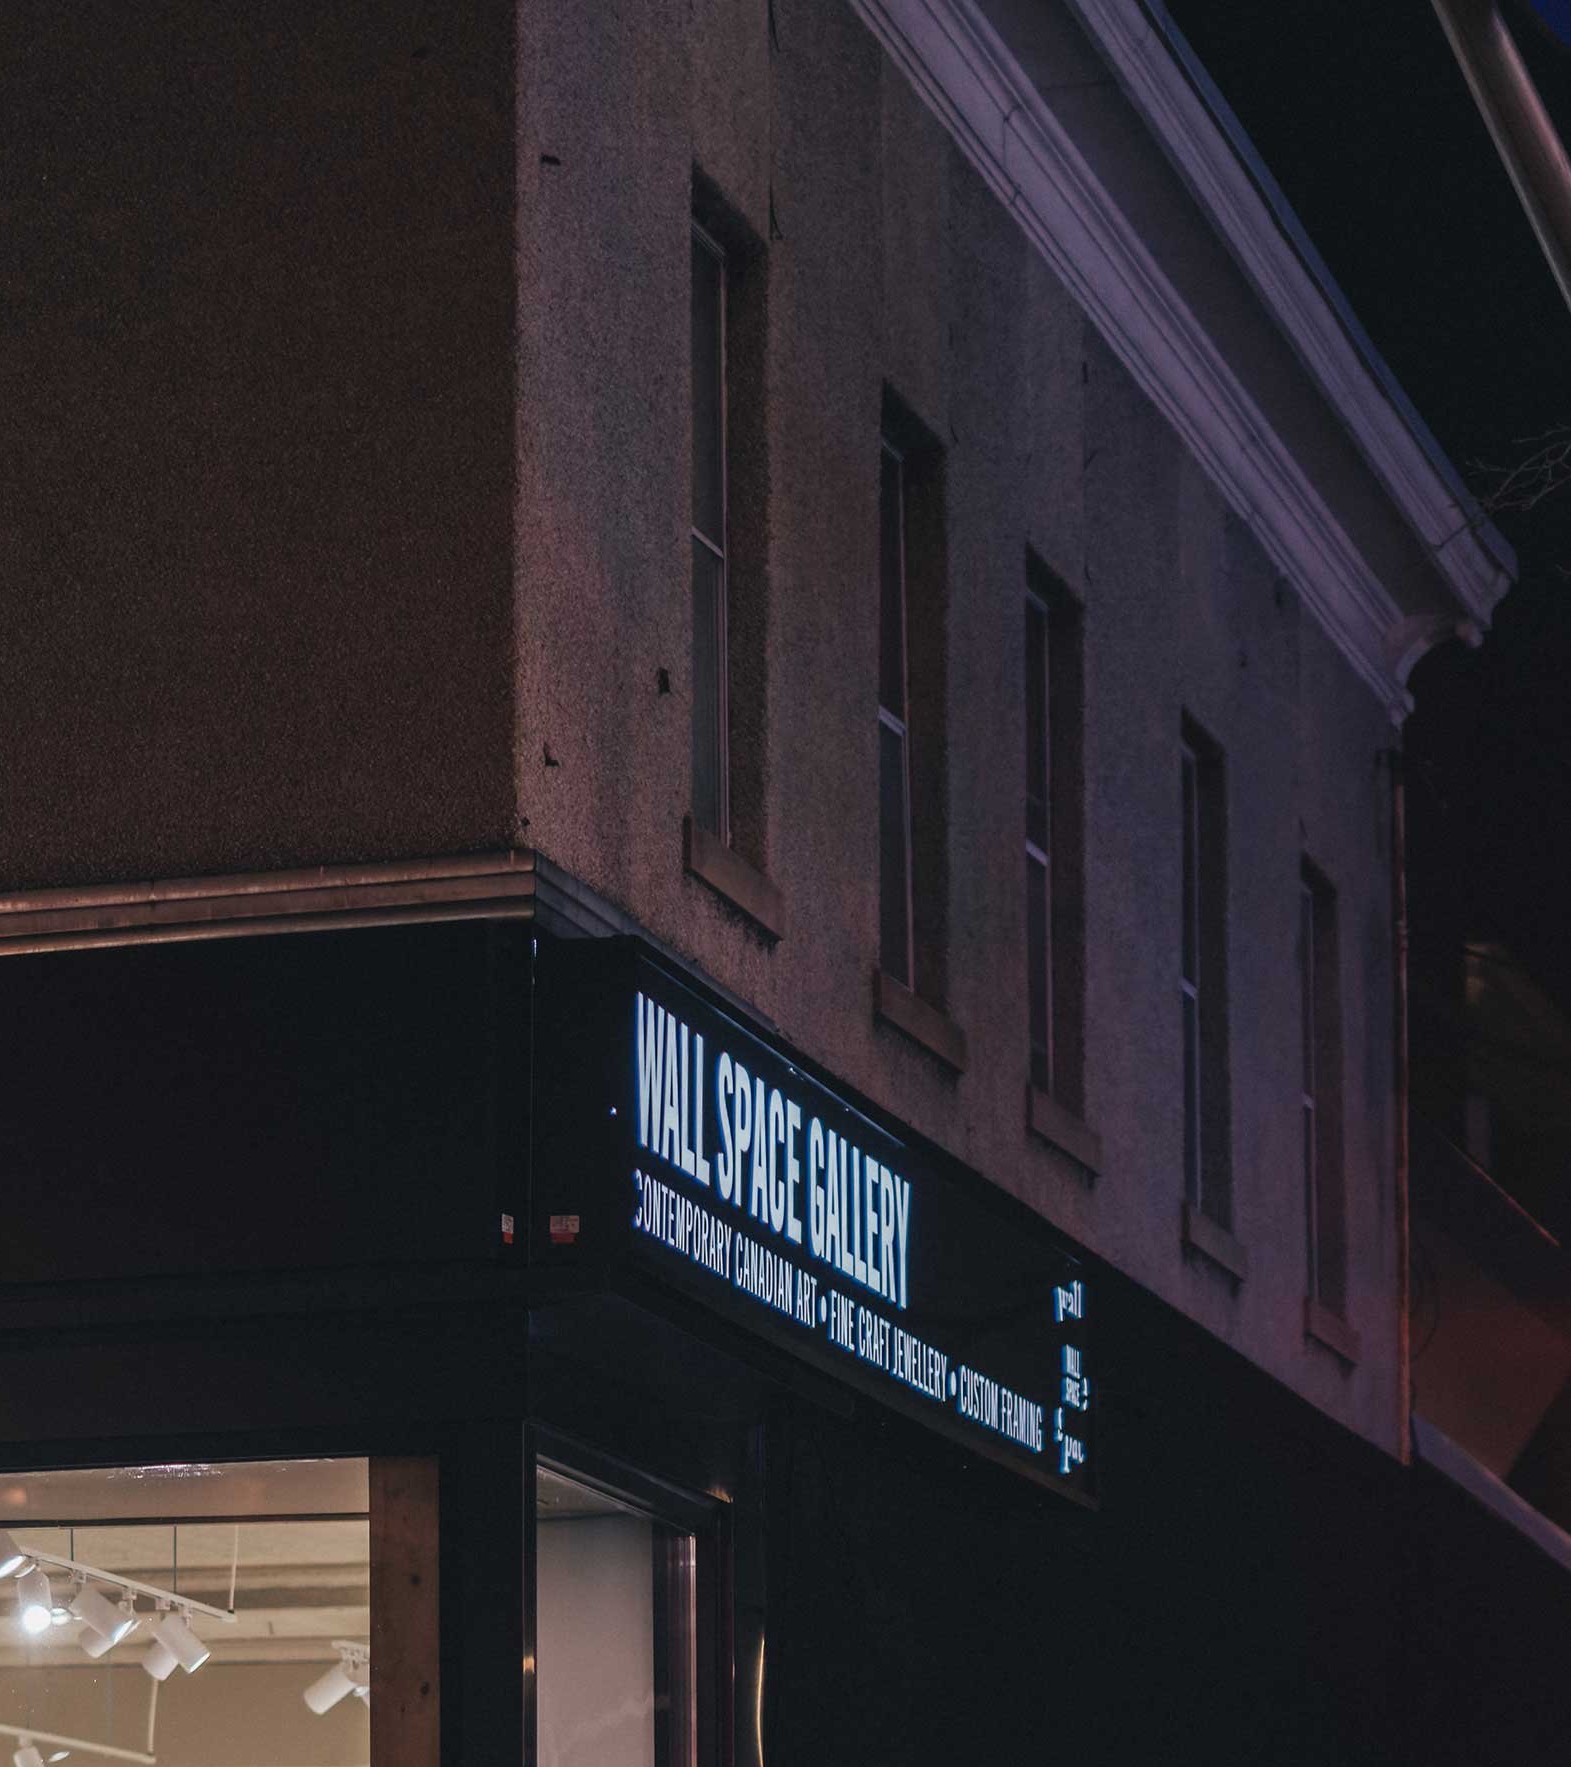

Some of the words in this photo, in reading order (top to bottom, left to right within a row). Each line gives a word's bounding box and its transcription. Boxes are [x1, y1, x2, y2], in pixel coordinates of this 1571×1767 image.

[638, 991, 709, 1187] WALL
[716, 1052, 801, 1245] SPACE
[810, 1117, 909, 1310] GALLERY
[634, 1168, 731, 1279] CONTEMPORARY
[736, 1232, 793, 1315] CANADIAN
[797, 1270, 817, 1329] ART
[830, 1290, 855, 1351] FINE
[859, 1305, 890, 1370] CRAFT
[892, 1326, 948, 1403] JEWELLERY
[960, 1365, 998, 1429] CUSTOM
[1001, 1388, 1042, 1452] FRAMING
